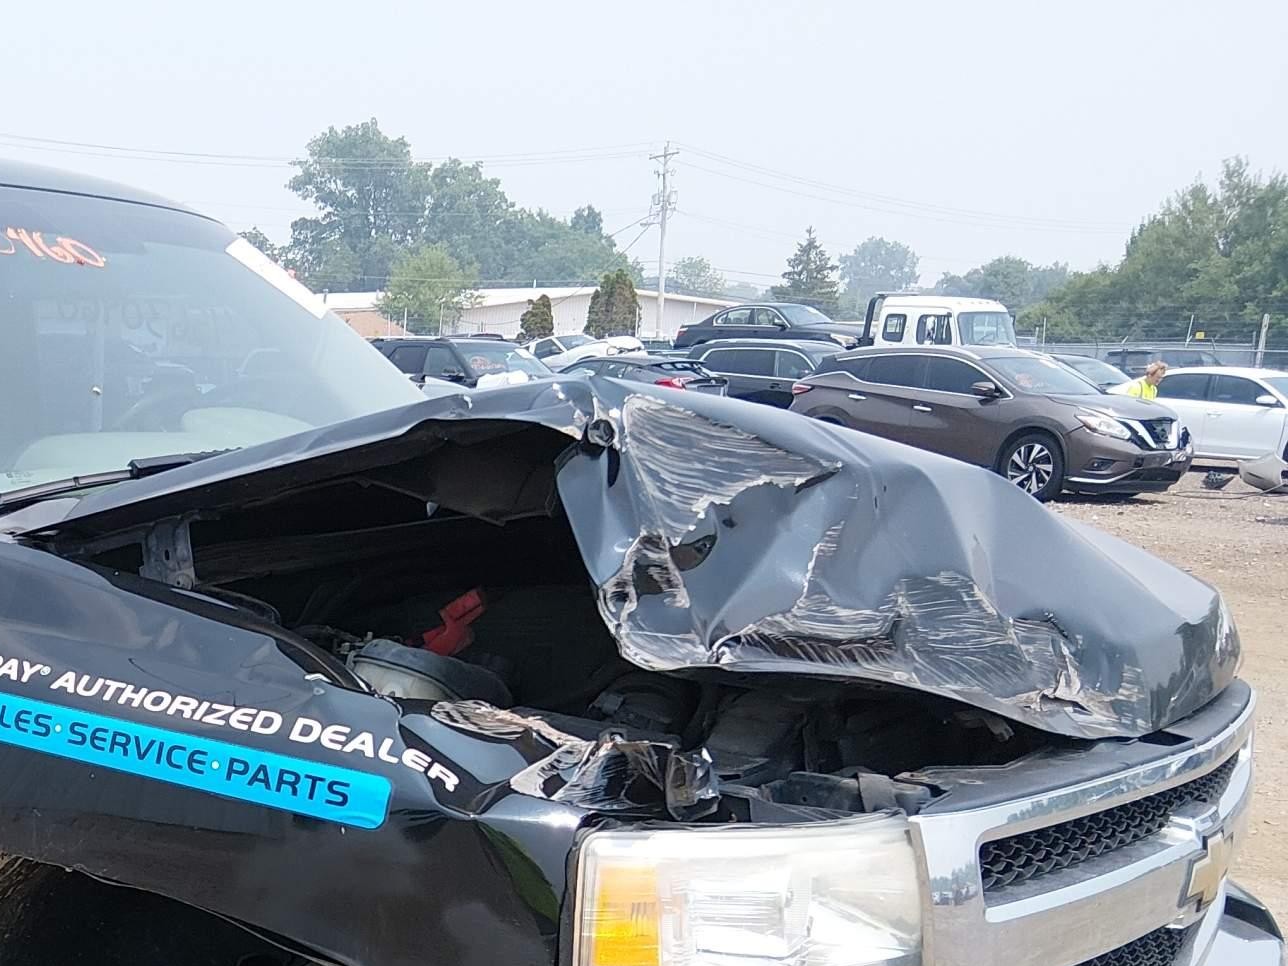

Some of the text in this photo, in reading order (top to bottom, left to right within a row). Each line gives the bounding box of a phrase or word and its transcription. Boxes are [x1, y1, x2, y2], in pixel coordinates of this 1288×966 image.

[49, 671, 283, 735] AUTHORIZED
[288, 717, 460, 792] DEALER
[67, 721, 208, 775] SERVICE
[225, 758, 350, 807] PARTS
